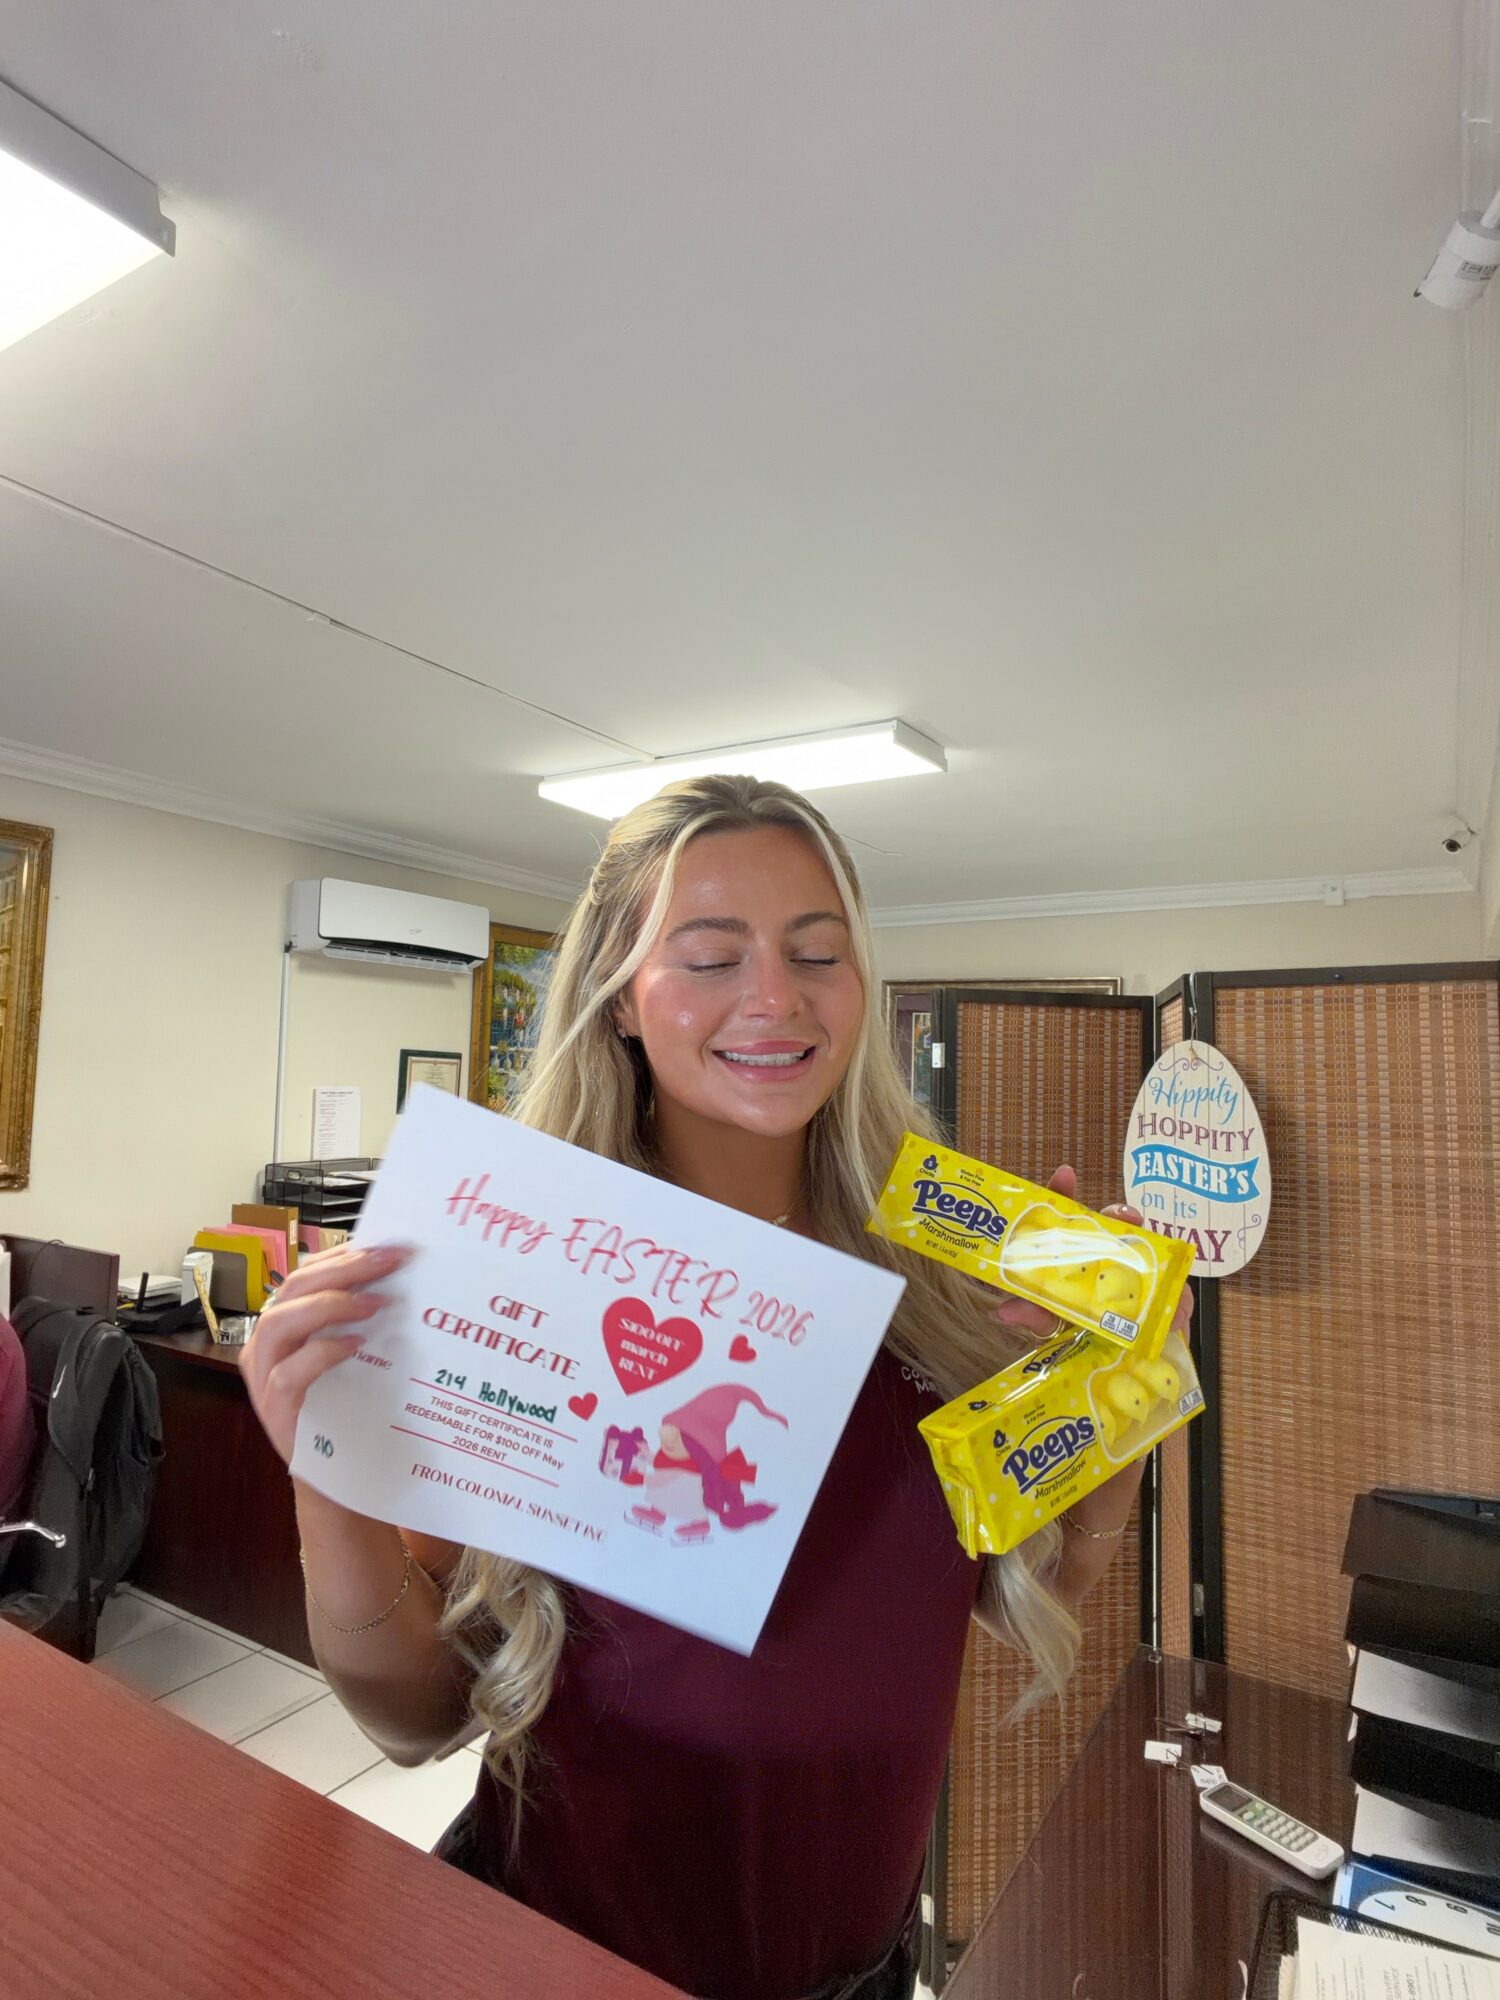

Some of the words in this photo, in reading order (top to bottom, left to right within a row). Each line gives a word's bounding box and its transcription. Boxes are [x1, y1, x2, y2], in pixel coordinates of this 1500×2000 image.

[1148, 1072, 1240, 1125] Hippity
[1137, 1112, 1255, 1152] HOPPITY
[1137, 1151, 1251, 1196] EASTER'S
[912, 1179, 1008, 1236] Peeps
[1141, 1190, 1165, 1211] on
[1173, 1195, 1197, 1219] its
[445, 1173, 554, 1255] Happy
[562, 1217, 739, 1319] EASTER
[739, 1290, 815, 1347] 2026
[919, 1218, 980, 1251] Marshmallow
[489, 1295, 550, 1329] GIFT
[422, 1307, 581, 1380] CERTIFICATE
[431, 1396, 454, 1411] THIS
[454, 1404, 478, 1419] GIFT
[478, 1414, 543, 1445] CERTIFICATE
[543, 1436, 554, 1449] IS
[434, 1369, 467, 1390] 214
[478, 1381, 558, 1424] Hollywood
[404, 1403, 471, 1434] REDEEMABLE
[472, 1426, 494, 1442] FOR
[494, 1433, 520, 1452] $100
[521, 1445, 543, 1460] OFF
[542, 1453, 565, 1471] May
[452, 1436, 479, 1452] 2026
[480, 1446, 508, 1462] RENT
[1002, 1416, 1095, 1487] Peeps
[411, 1463, 453, 1487] FROM
[456, 1478, 524, 1513] COLONIAL
[527, 1502, 584, 1534] SUNSET
[1034, 1460, 1086, 1500] Marshmallow
